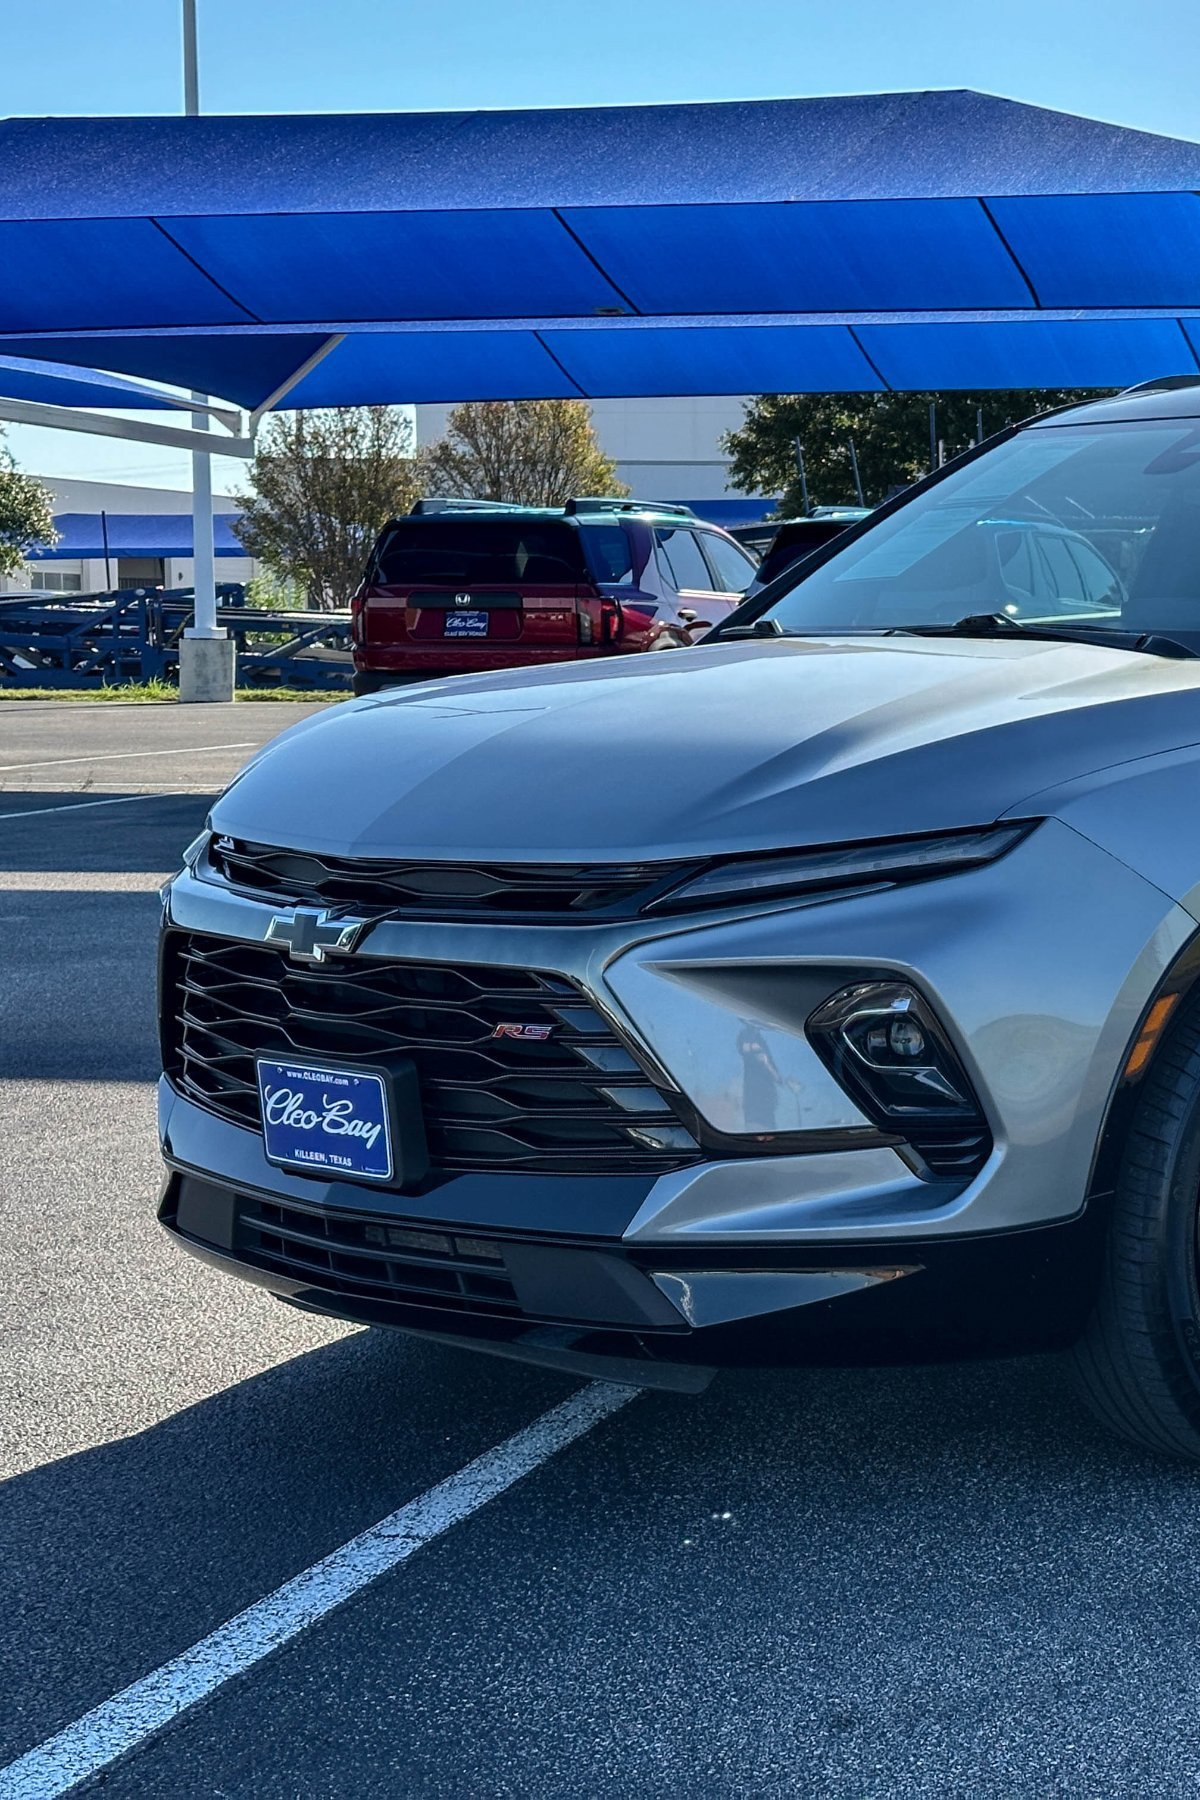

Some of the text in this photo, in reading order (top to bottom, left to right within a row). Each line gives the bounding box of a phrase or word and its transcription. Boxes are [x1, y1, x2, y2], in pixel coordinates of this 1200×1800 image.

[492, 1024, 552, 1040] RS
[286, 1070, 349, 1086] www.CLEOBAY.com
[264, 1085, 381, 1149] Cleo Bay
[294, 1149, 352, 1167] KILLEEN, TEXAS
